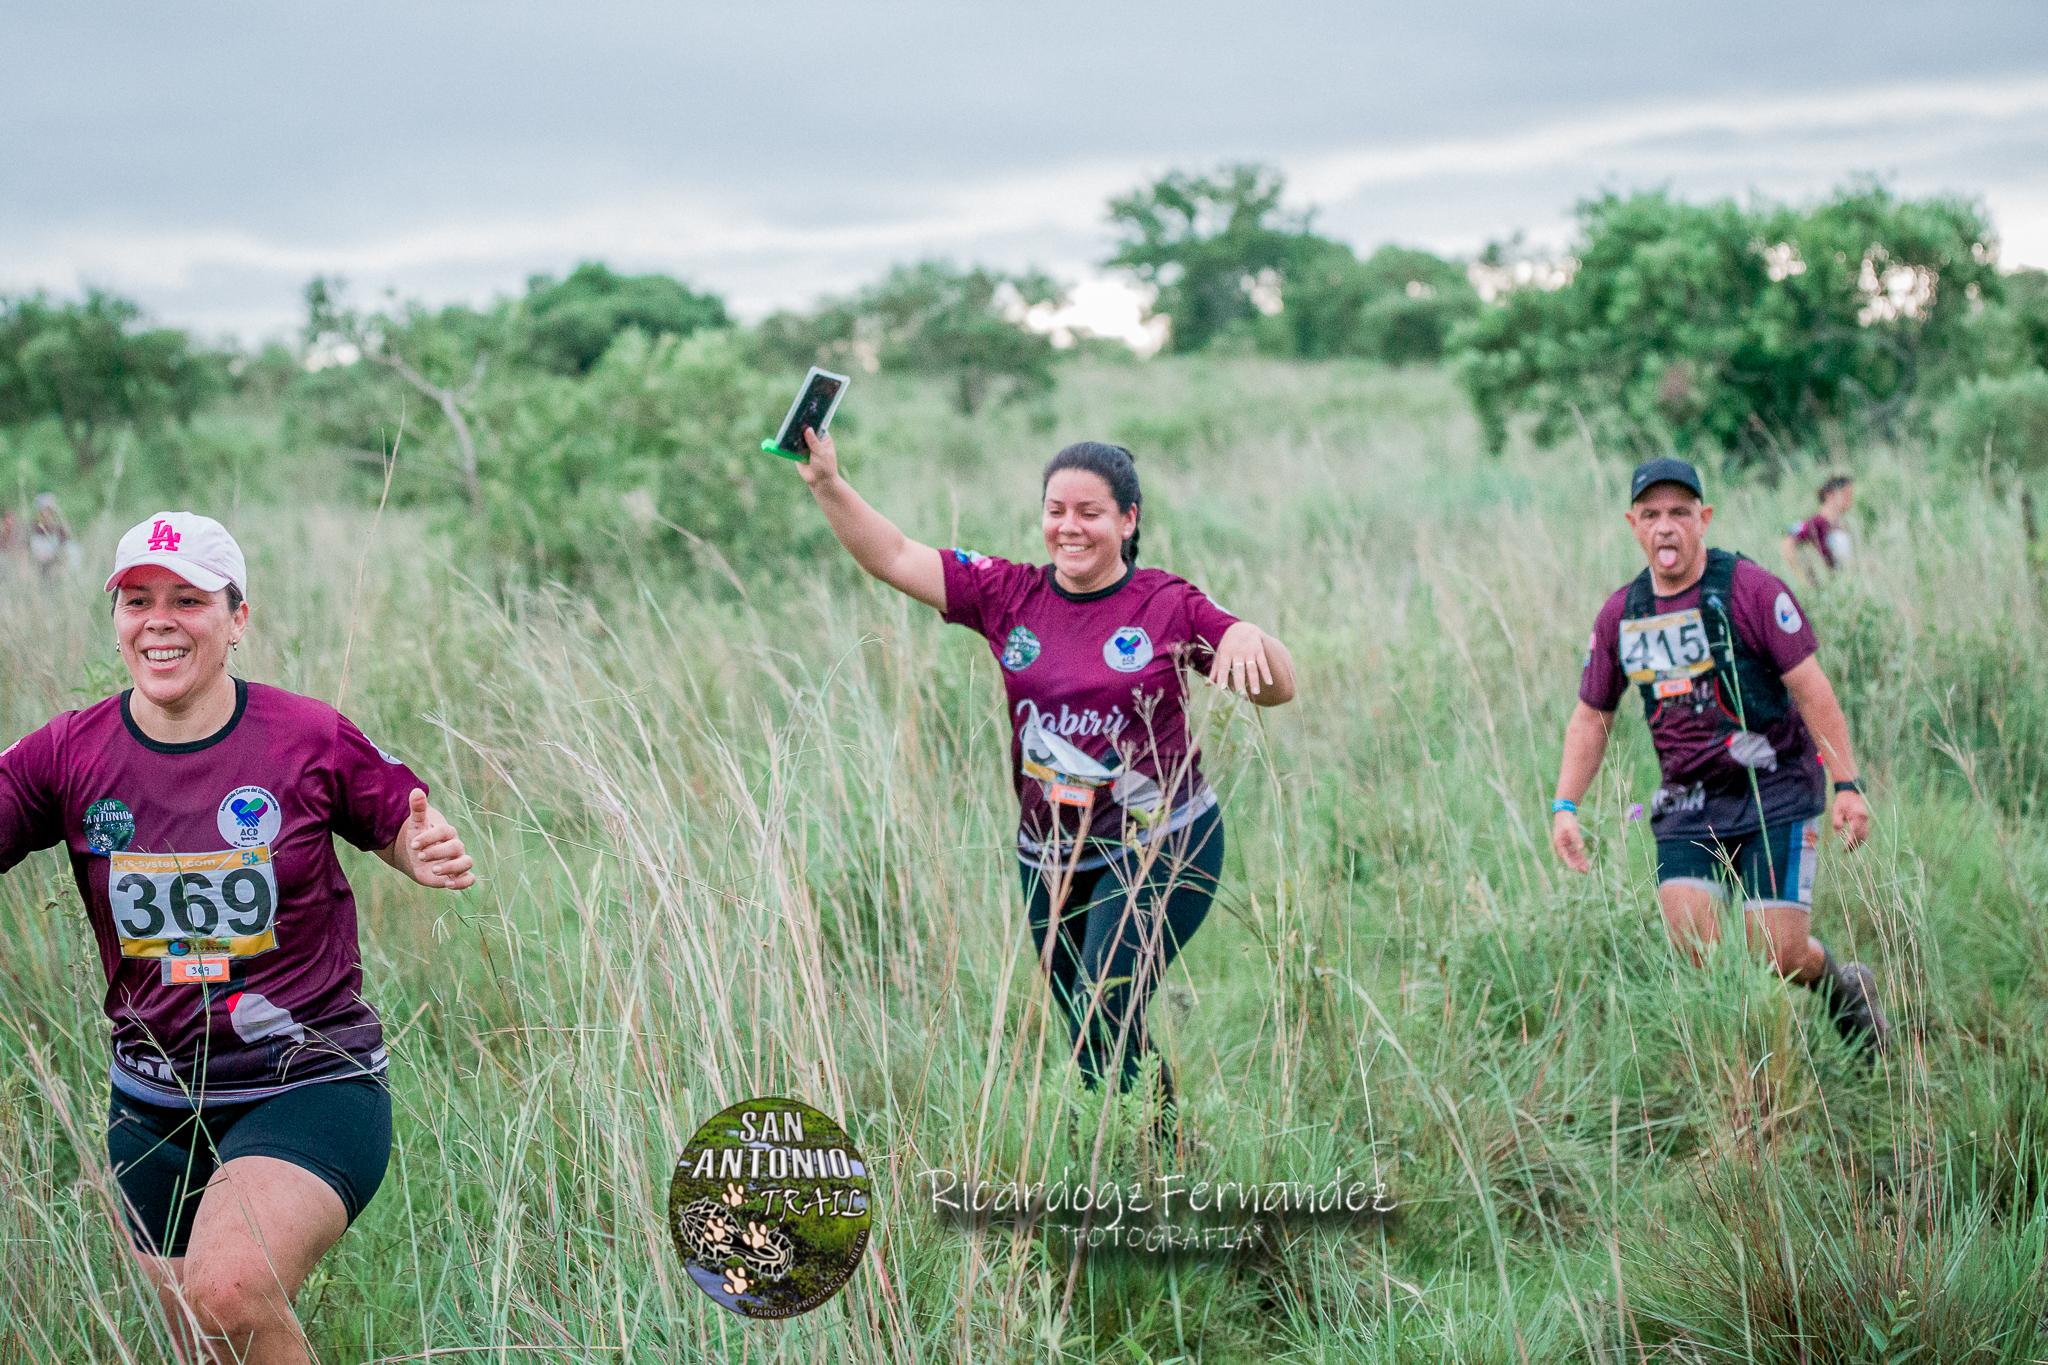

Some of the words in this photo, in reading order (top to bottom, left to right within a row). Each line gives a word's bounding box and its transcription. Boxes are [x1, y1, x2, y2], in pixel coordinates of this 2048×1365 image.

[148, 520, 181, 551] LA
[1625, 623, 1705, 670] 415
[97, 801, 116, 811] SAN
[117, 868, 272, 939] 369
